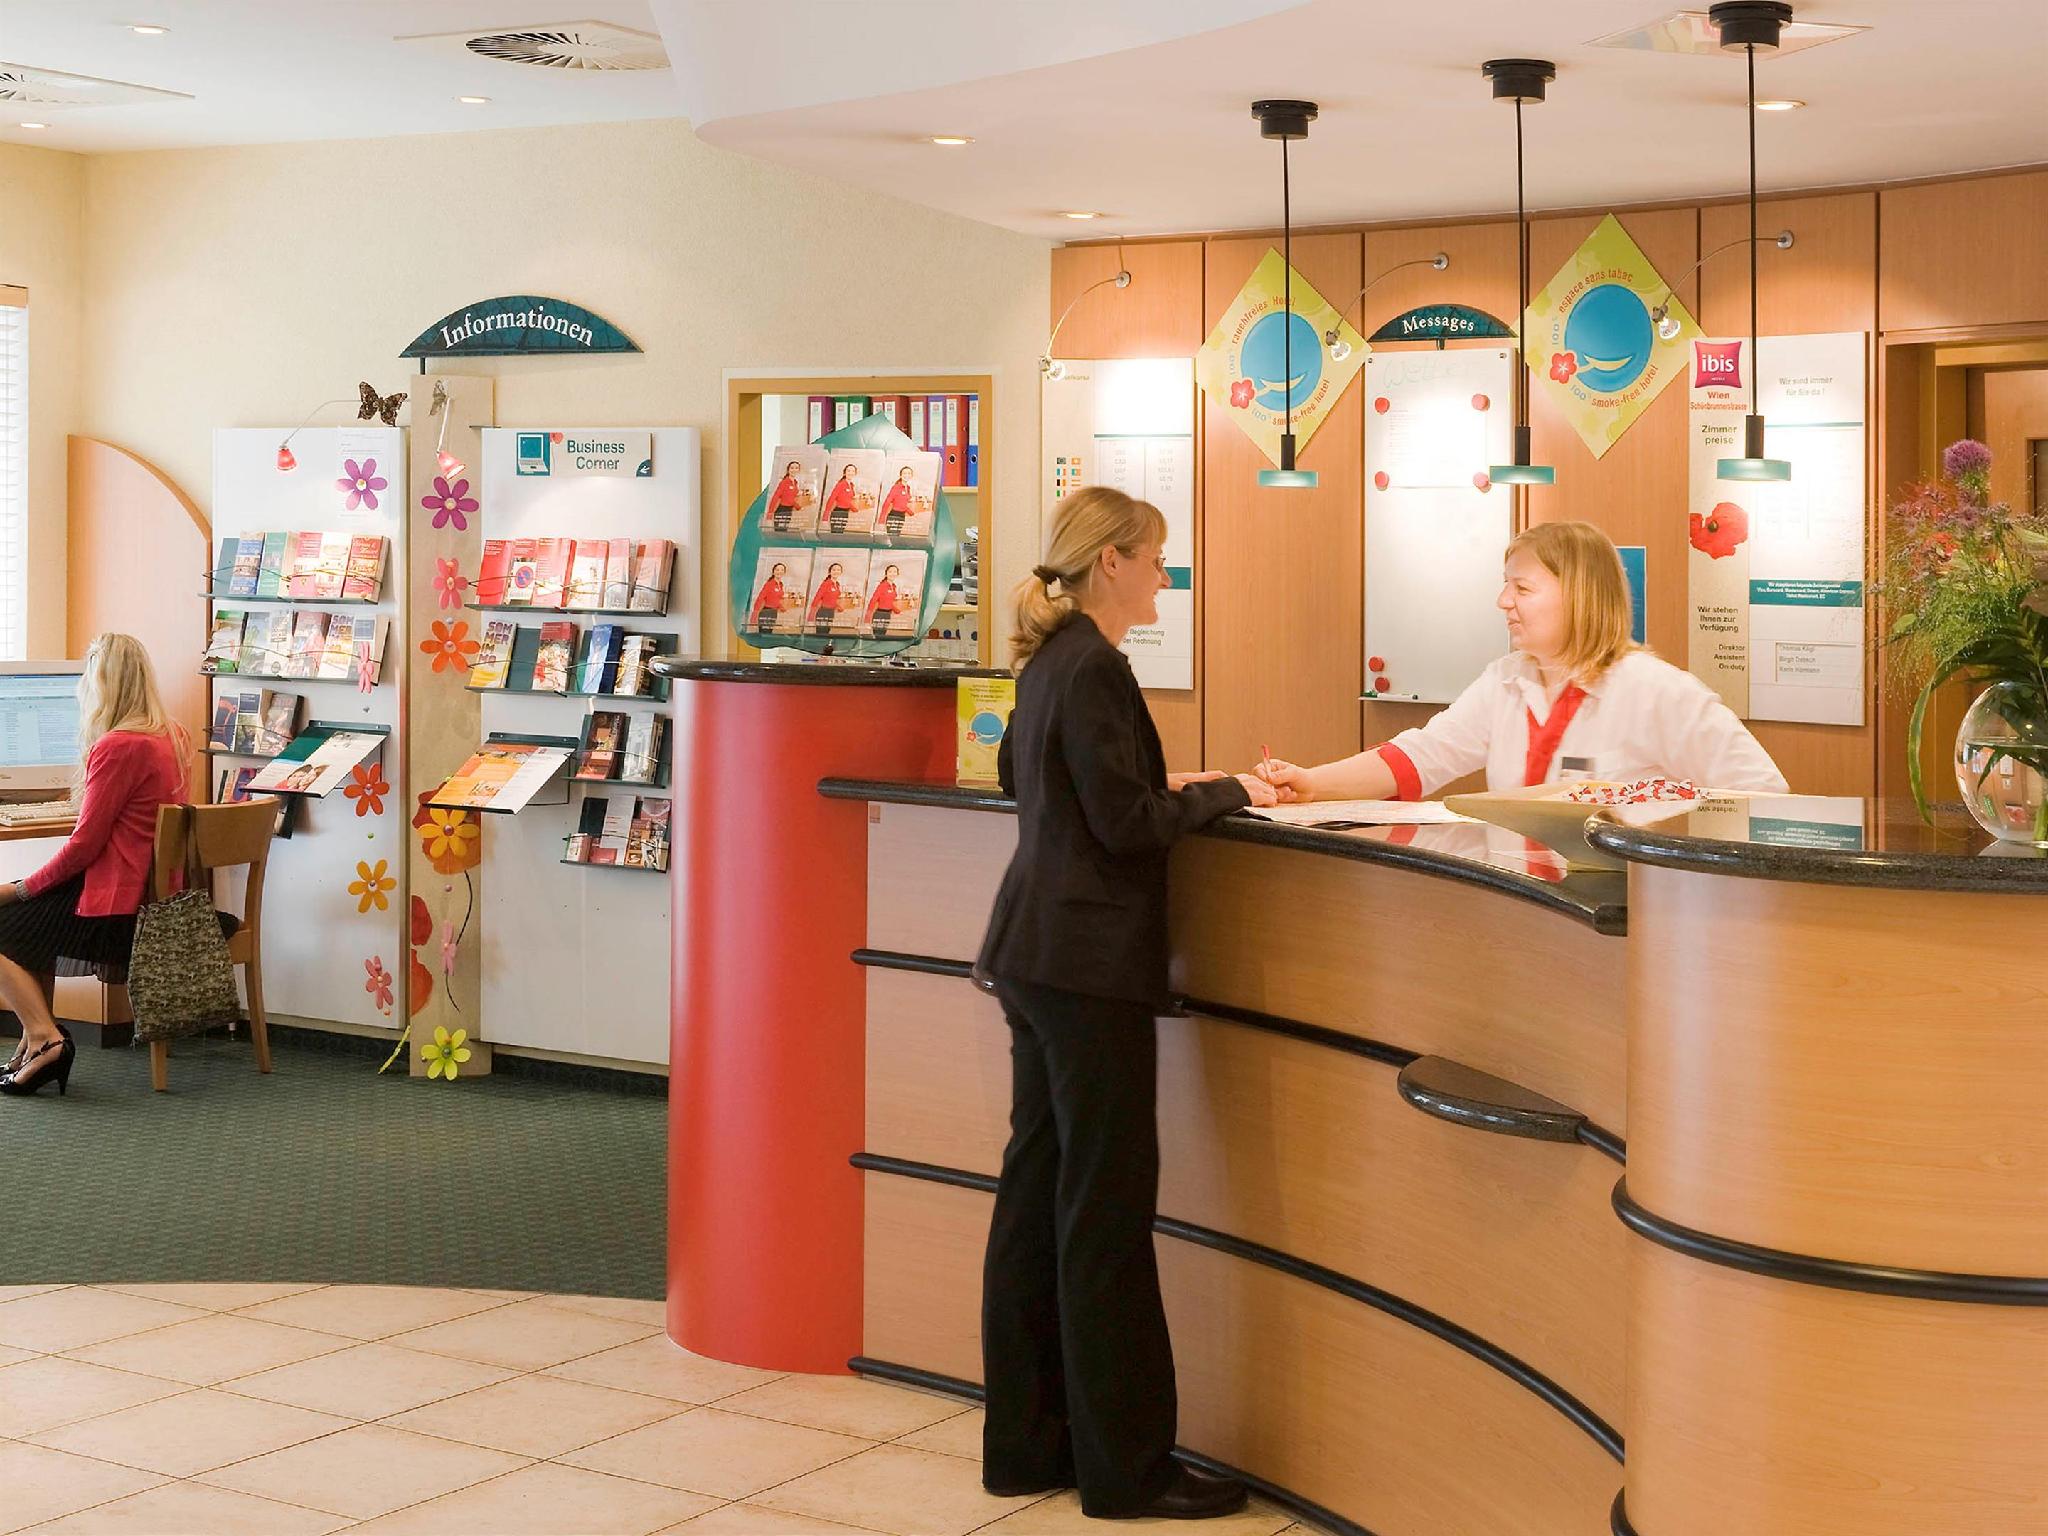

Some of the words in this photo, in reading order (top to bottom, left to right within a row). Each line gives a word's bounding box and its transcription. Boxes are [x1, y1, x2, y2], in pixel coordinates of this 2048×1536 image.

[1558, 281, 1584, 313] espace
[1584, 271, 1606, 285] sans
[1608, 268, 1633, 283] tabac
[1273, 295, 1296, 307] Hol
[440, 305, 594, 349] Informationen
[1402, 315, 1475, 335] Messages
[1701, 353, 1735, 373] ibis
[1592, 389, 1641, 407] smoke-free
[1640, 364, 1659, 391] hotel
[1272, 404, 1317, 425] smke-free
[1314, 378, 1330, 404] hotel
[1707, 391, 1730, 400] Wien
[1702, 425, 1738, 433] Zimmer
[566, 439, 625, 454] Business
[1705, 435, 1734, 446] preise
[576, 456, 620, 471] Corner
[486, 620, 513, 634] SOM
[1699, 624, 1739, 633] Verfügung
[1718, 643, 1745, 651] Direktor
[1713, 653, 1745, 661] Assistent
